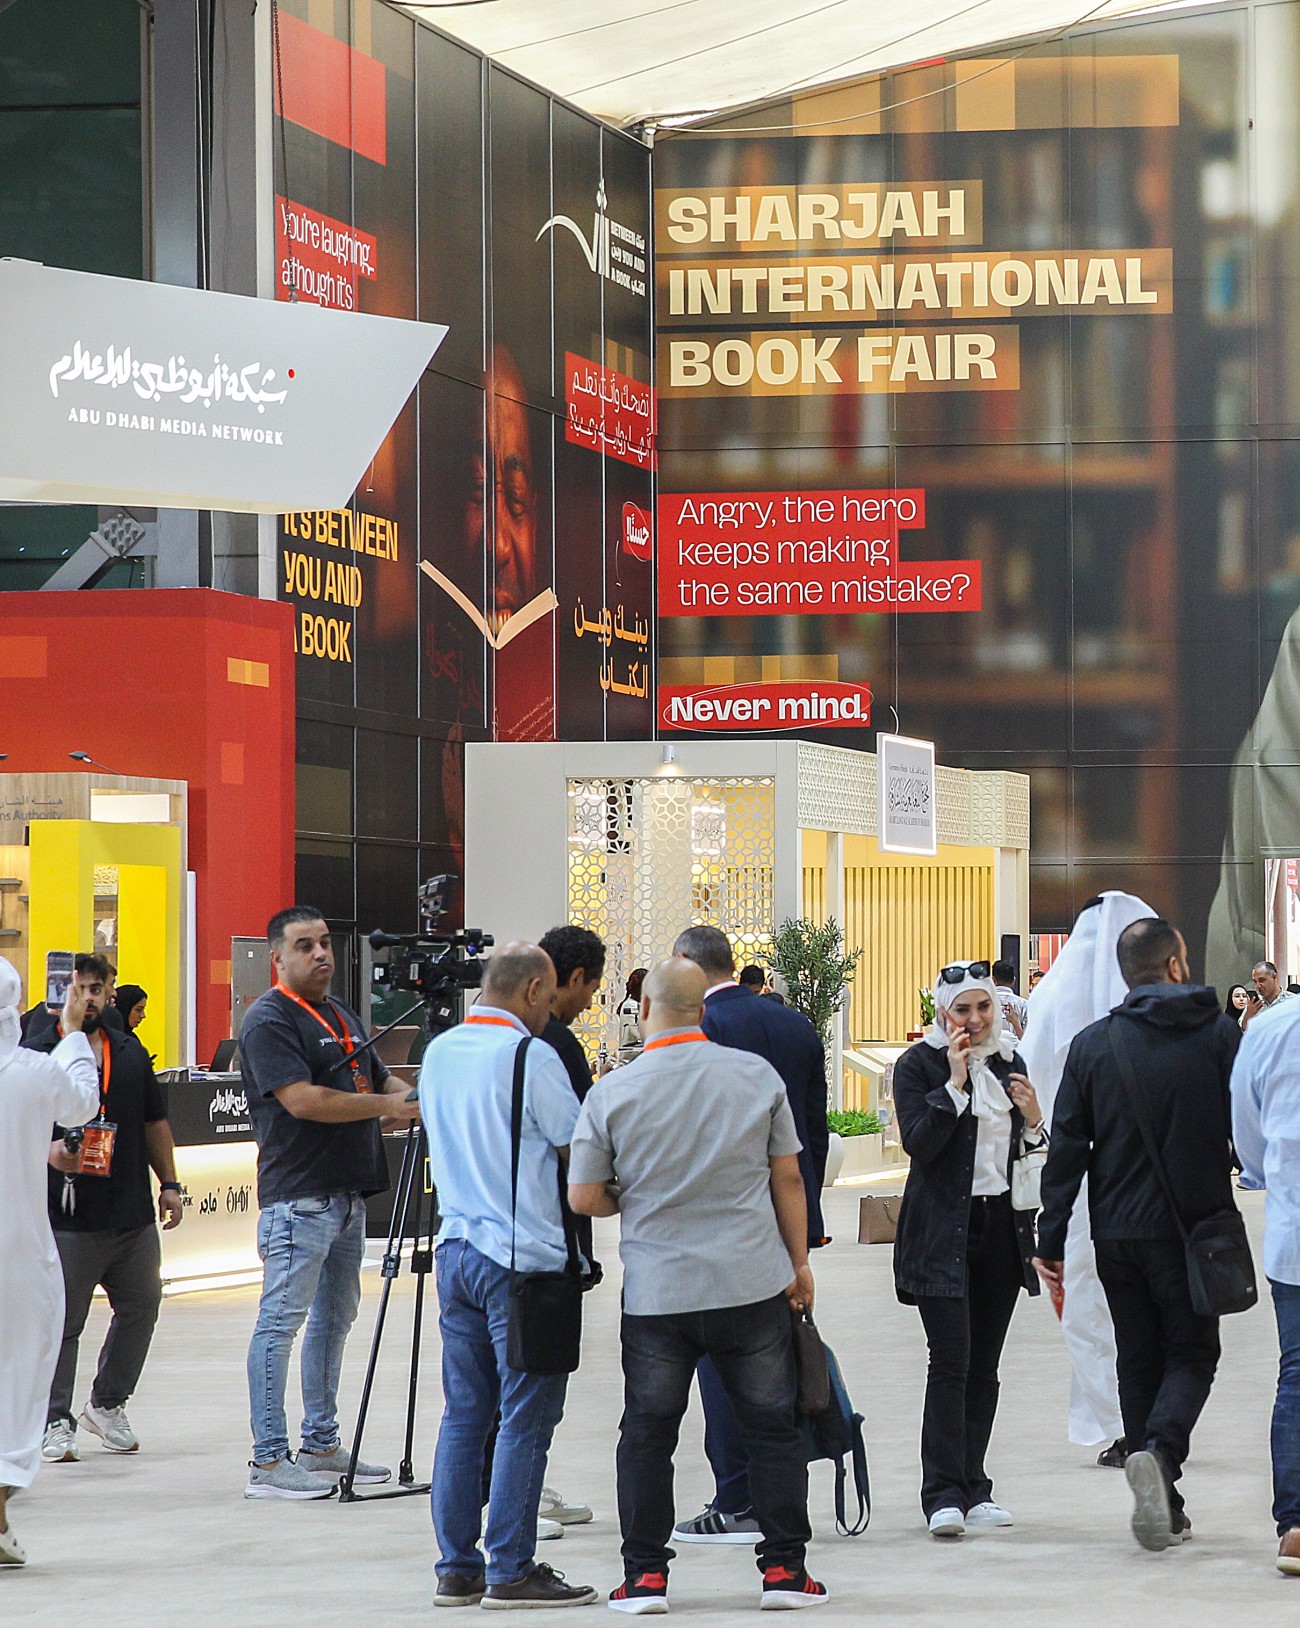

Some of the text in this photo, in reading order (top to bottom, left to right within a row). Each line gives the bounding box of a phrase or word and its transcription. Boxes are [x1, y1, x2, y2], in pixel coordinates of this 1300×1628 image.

[667, 189, 965, 243] SHARJAH
[281, 204, 374, 275] You're laughing,
[282, 257, 353, 309] athough it's
[669, 257, 1157, 315] INTERNATIONAL
[572, 368, 598, 397] تعلم
[669, 333, 998, 387] BOOK FAIR
[68, 407, 284, 445] ABU DHABI MEDIA NETWORK
[315, 508, 398, 562] BETWEEN
[677, 495, 917, 529] Angry, the hero
[678, 535, 891, 569] keeps making
[324, 561, 363, 607] AND
[678, 573, 971, 606] the same mistake?
[302, 612, 352, 663] BOOK
[574, 597, 649, 653] بينك وبين
[599, 656, 649, 699] الكتاب
[671, 692, 868, 723] Never mind,
[13, 809, 63, 821] Authority
